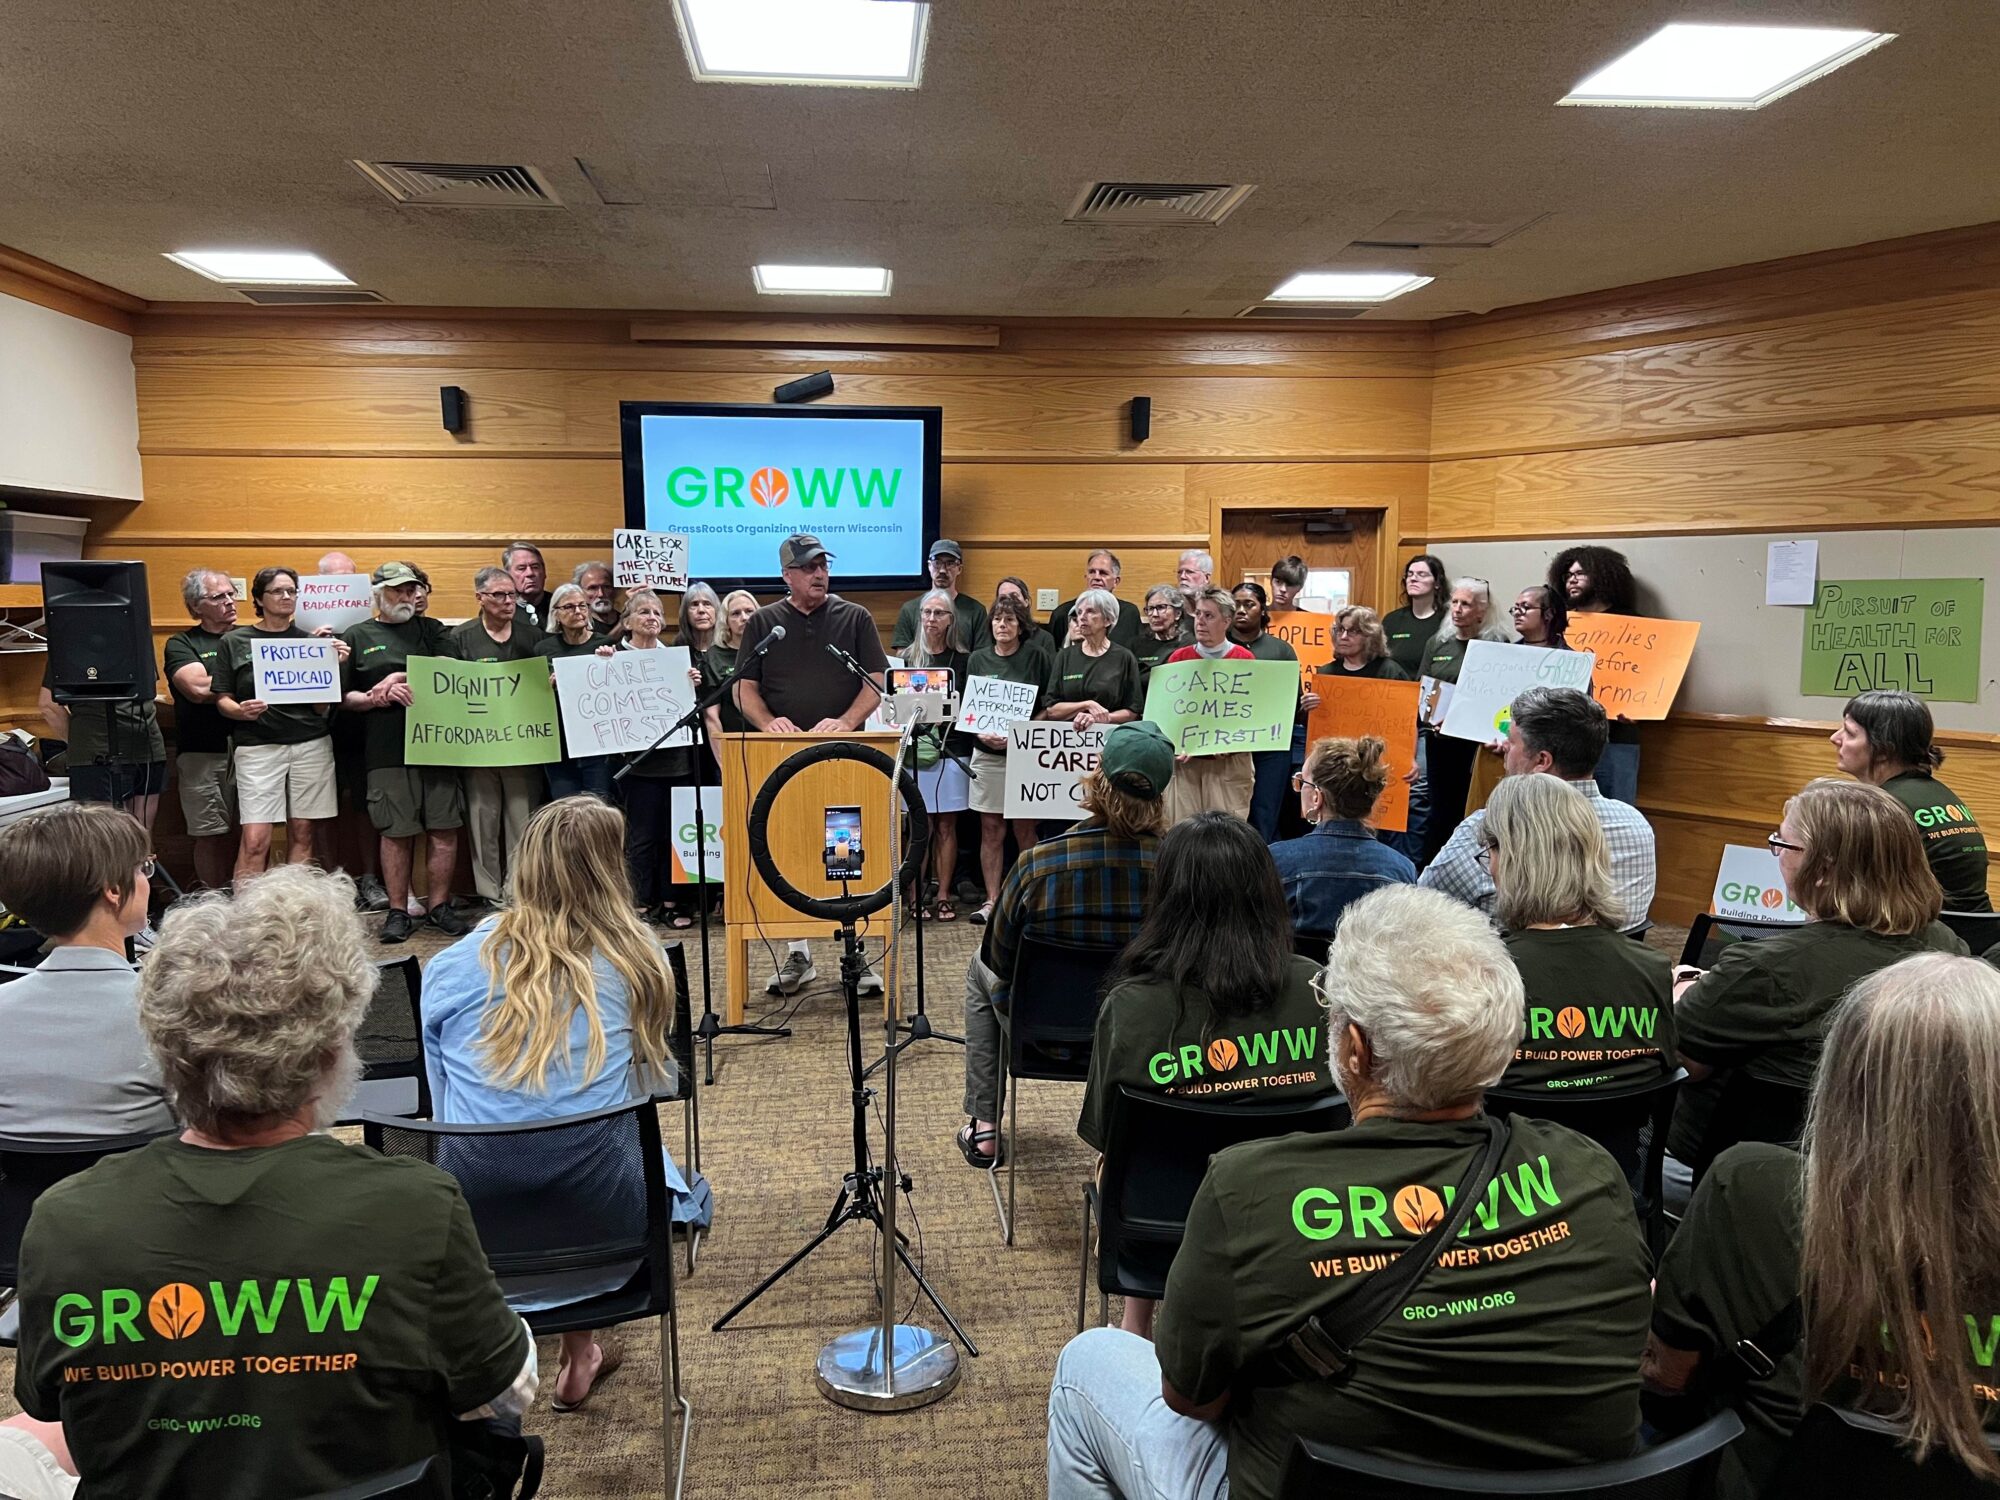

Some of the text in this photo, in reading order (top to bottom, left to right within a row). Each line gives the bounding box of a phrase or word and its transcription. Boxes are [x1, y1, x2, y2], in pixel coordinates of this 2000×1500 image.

[666, 466, 902, 508] GROWW
[668, 523, 902, 535] GrassRoots Organizing Western Wisconsin
[616, 533, 683, 551] CARE FOR
[635, 549, 674, 562] KIDS!
[617, 560, 676, 573] THEY'RE
[304, 584, 350, 595] PROTECT
[616, 573, 687, 587] THE FUTURE!
[302, 597, 371, 611] BADGERCARE!
[1930, 600, 1956, 616] OF
[1266, 625, 1325, 646] EOPLE
[1811, 622, 1961, 650] HEALTH FOR
[261, 645, 327, 662] PROTECT
[264, 670, 333, 685] MEDICAID
[587, 658, 664, 690] CARE
[1165, 671, 1253, 695] CARE
[1834, 652, 1933, 694] ALL
[433, 671, 521, 699] DIGNITY
[973, 680, 1035, 704] WE NEED
[1592, 677, 1665, 704] rma!
[577, 687, 685, 720] COMES
[966, 700, 1032, 718] AFFORDABLE
[1174, 699, 1253, 719] COMES
[977, 714, 1010, 731] CARE
[411, 722, 554, 746] AFFORDABLE CARE
[1013, 728, 1046, 750] WE
[1038, 750, 1099, 772] CARE
[1021, 782, 1061, 802] NOT
[683, 850, 721, 859] Buiing
[1720, 907, 1758, 920] Building
[1523, 1006, 1658, 1040] ROWW
[1149, 1026, 1317, 1084] GROWW
[1525, 1050, 1558, 1061] BUILD
[1561, 1050, 1602, 1061] POWER
[1215, 1078, 1259, 1092] POWER
[1261, 1071, 1317, 1087] TOGETHER
[1310, 1259, 1343, 1278] WE
[1432, 1248, 1479, 1268] WER
[1482, 1221, 1571, 1262] TOGETHER
[53, 1275, 380, 1348] GROWW
[1402, 1291, 1516, 1320] GRO-WW.ORG
[63, 1352, 358, 1383] WE BUILD POWER TOGETHER
[147, 1413, 261, 1434] GRO-WW.ORG
